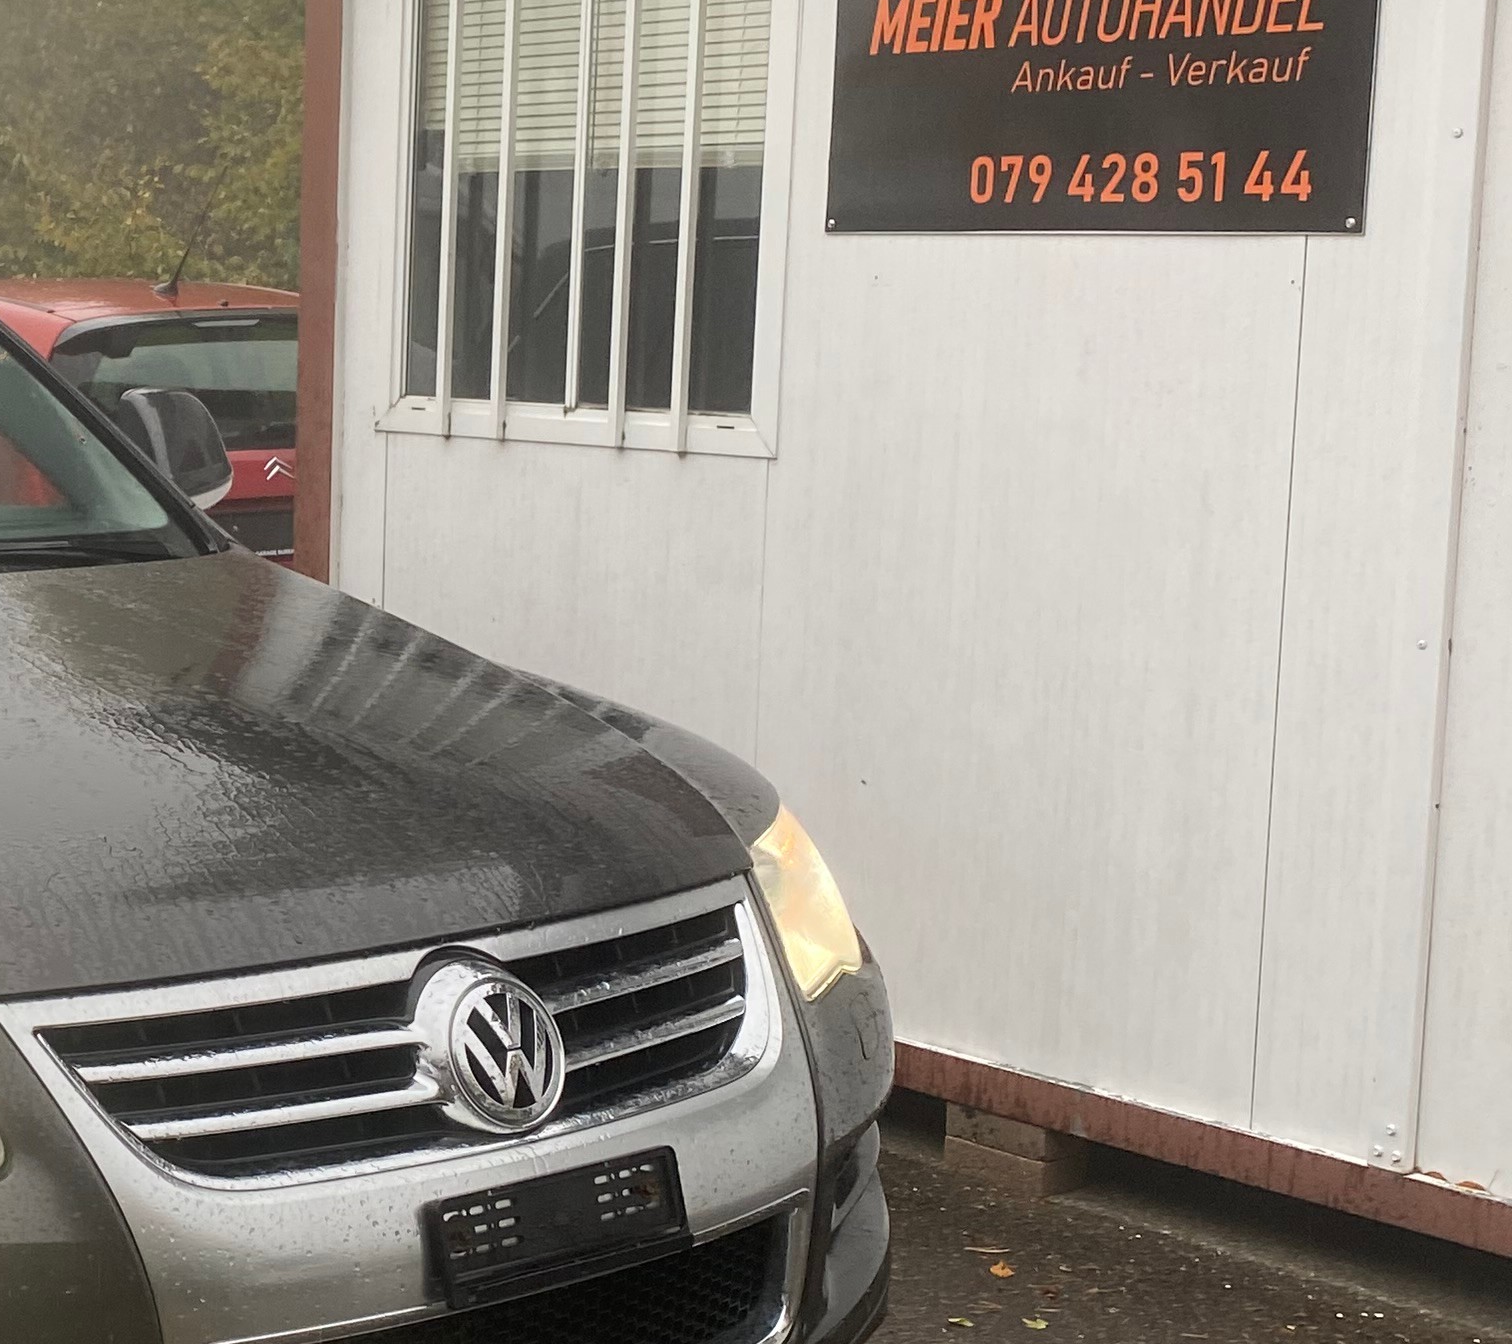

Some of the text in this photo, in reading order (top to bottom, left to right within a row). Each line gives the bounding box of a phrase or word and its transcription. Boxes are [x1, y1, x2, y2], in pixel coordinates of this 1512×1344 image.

[1011, 56, 1134, 93] Ankauf
[1169, 48, 1311, 86] Verkauf
[969, 149, 1313, 205] 079 428 51 44
[455, 981, 561, 1117] VW
